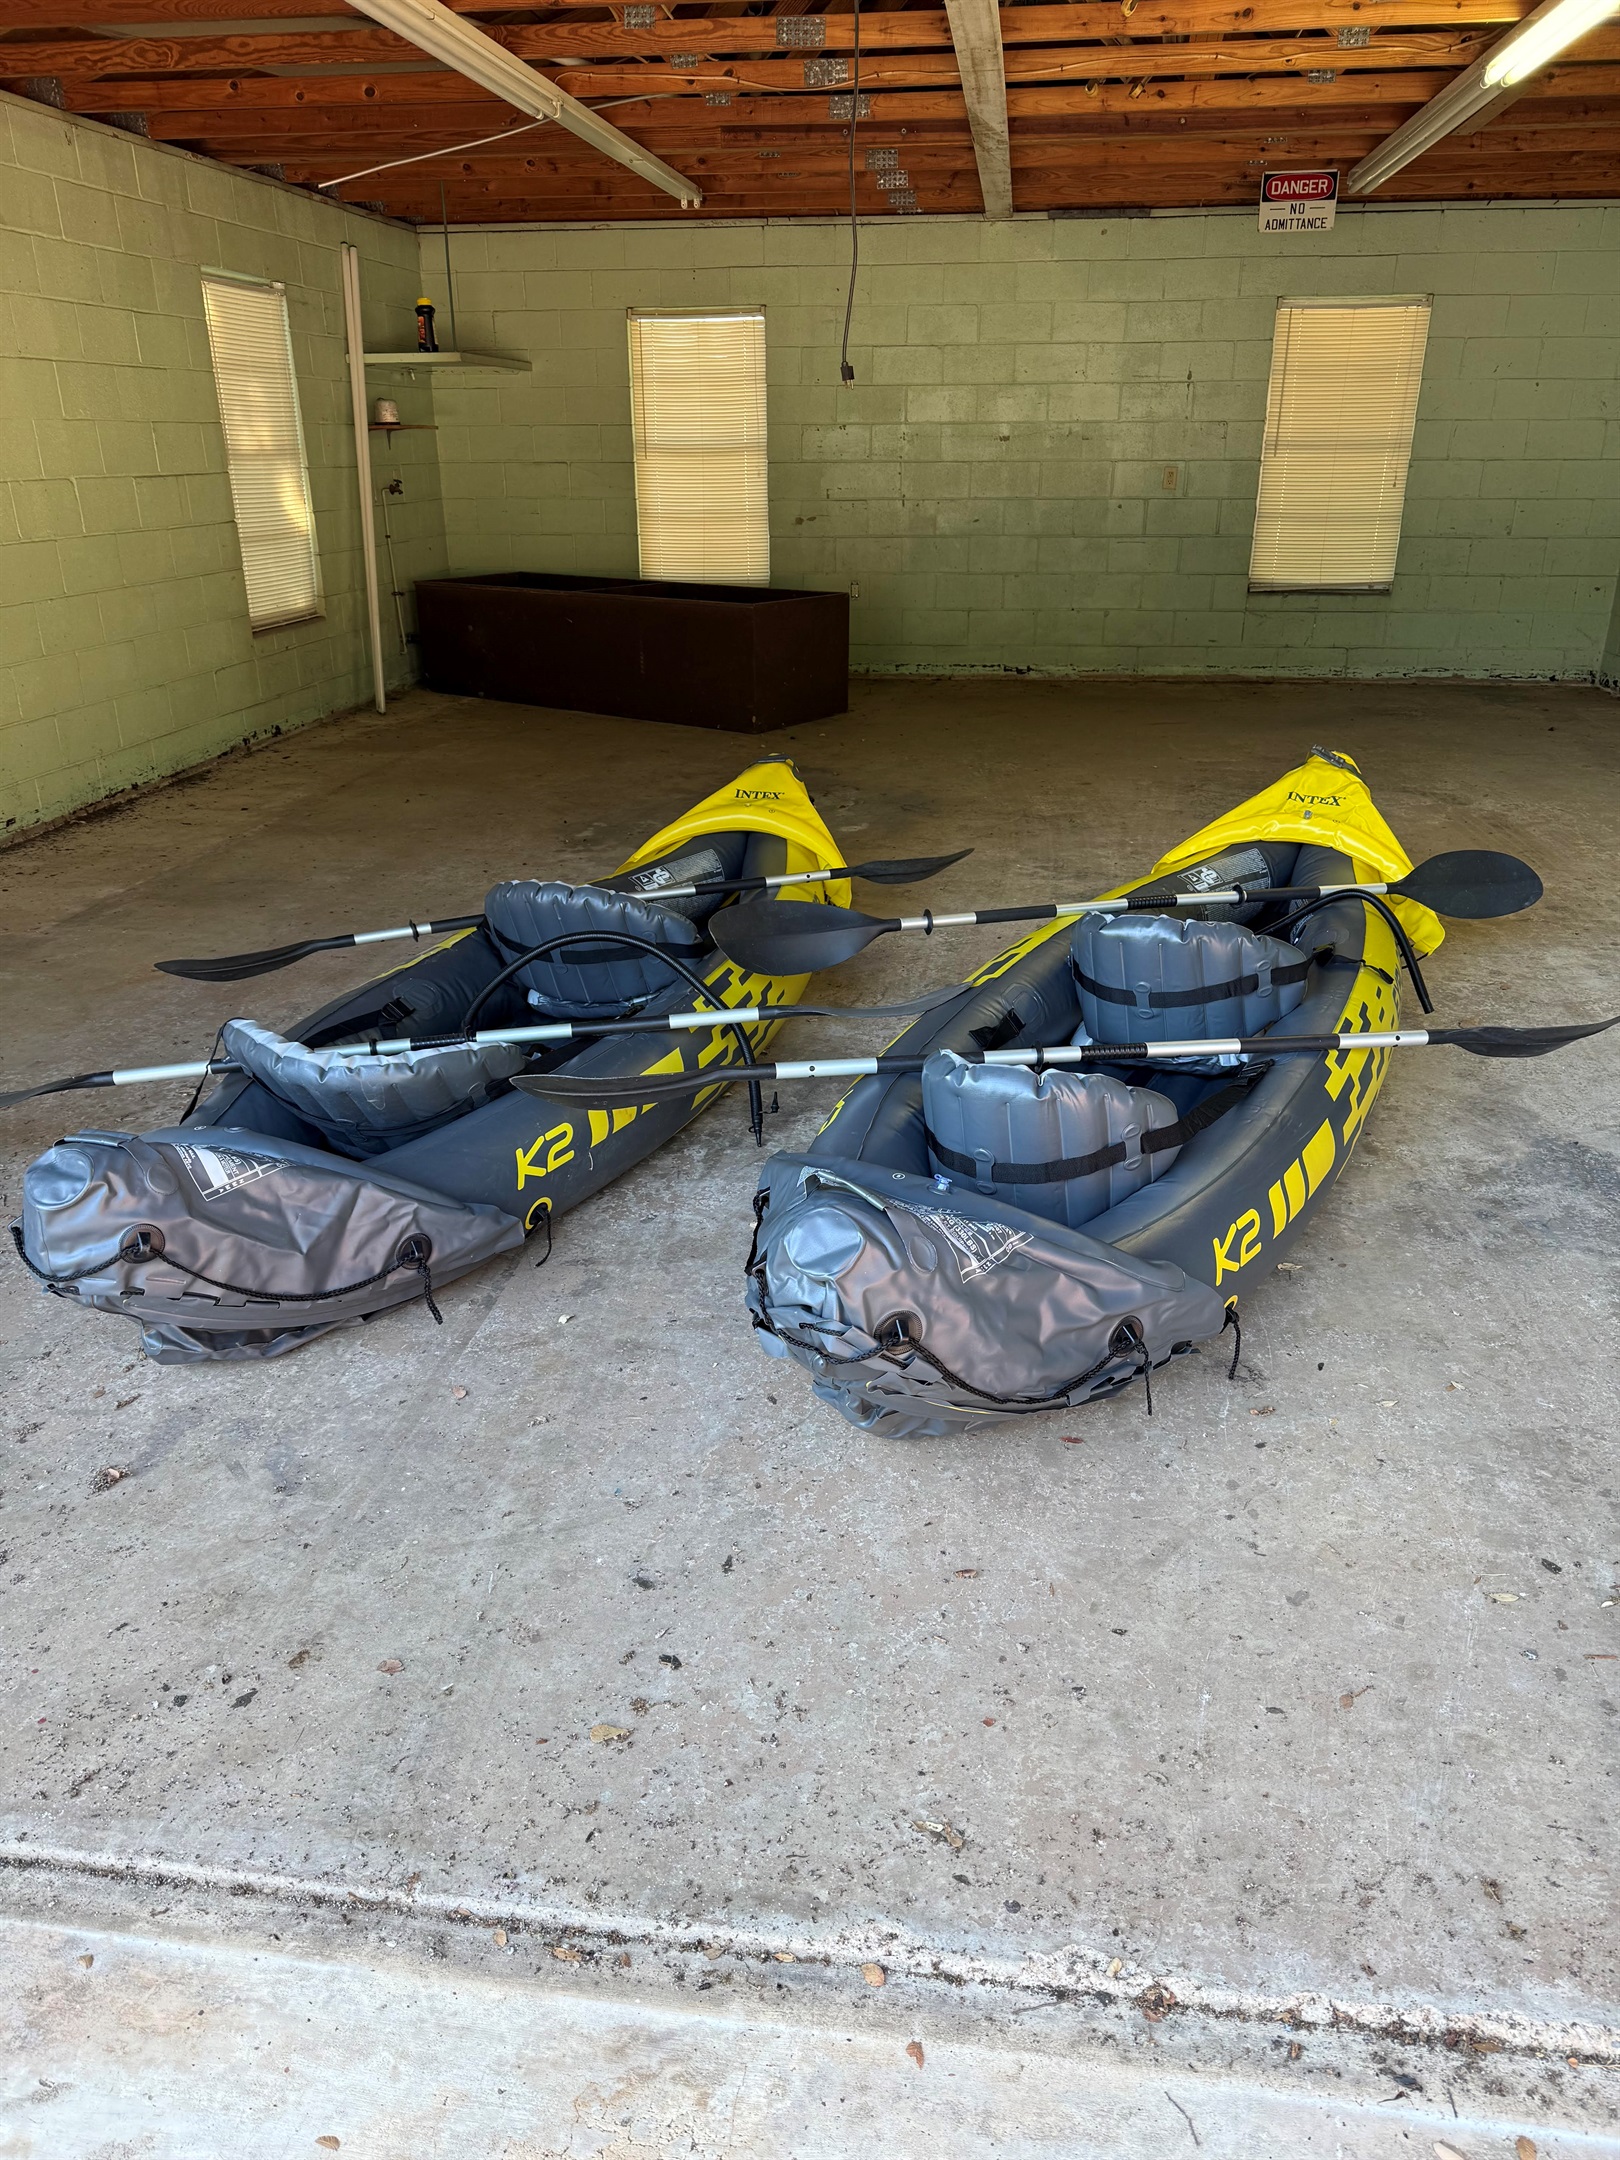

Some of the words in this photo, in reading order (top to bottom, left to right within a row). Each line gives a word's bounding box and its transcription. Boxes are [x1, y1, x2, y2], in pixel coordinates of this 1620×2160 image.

[1271, 179, 1328, 195] DANGER
[1289, 203, 1306, 215] NO
[1264, 217, 1328, 231] ADMITTANCE
[735, 788, 781, 800] INTEX
[1287, 791, 1341, 807] INTEX
[515, 1122, 575, 1190] K2
[1212, 1208, 1262, 1287] K2
